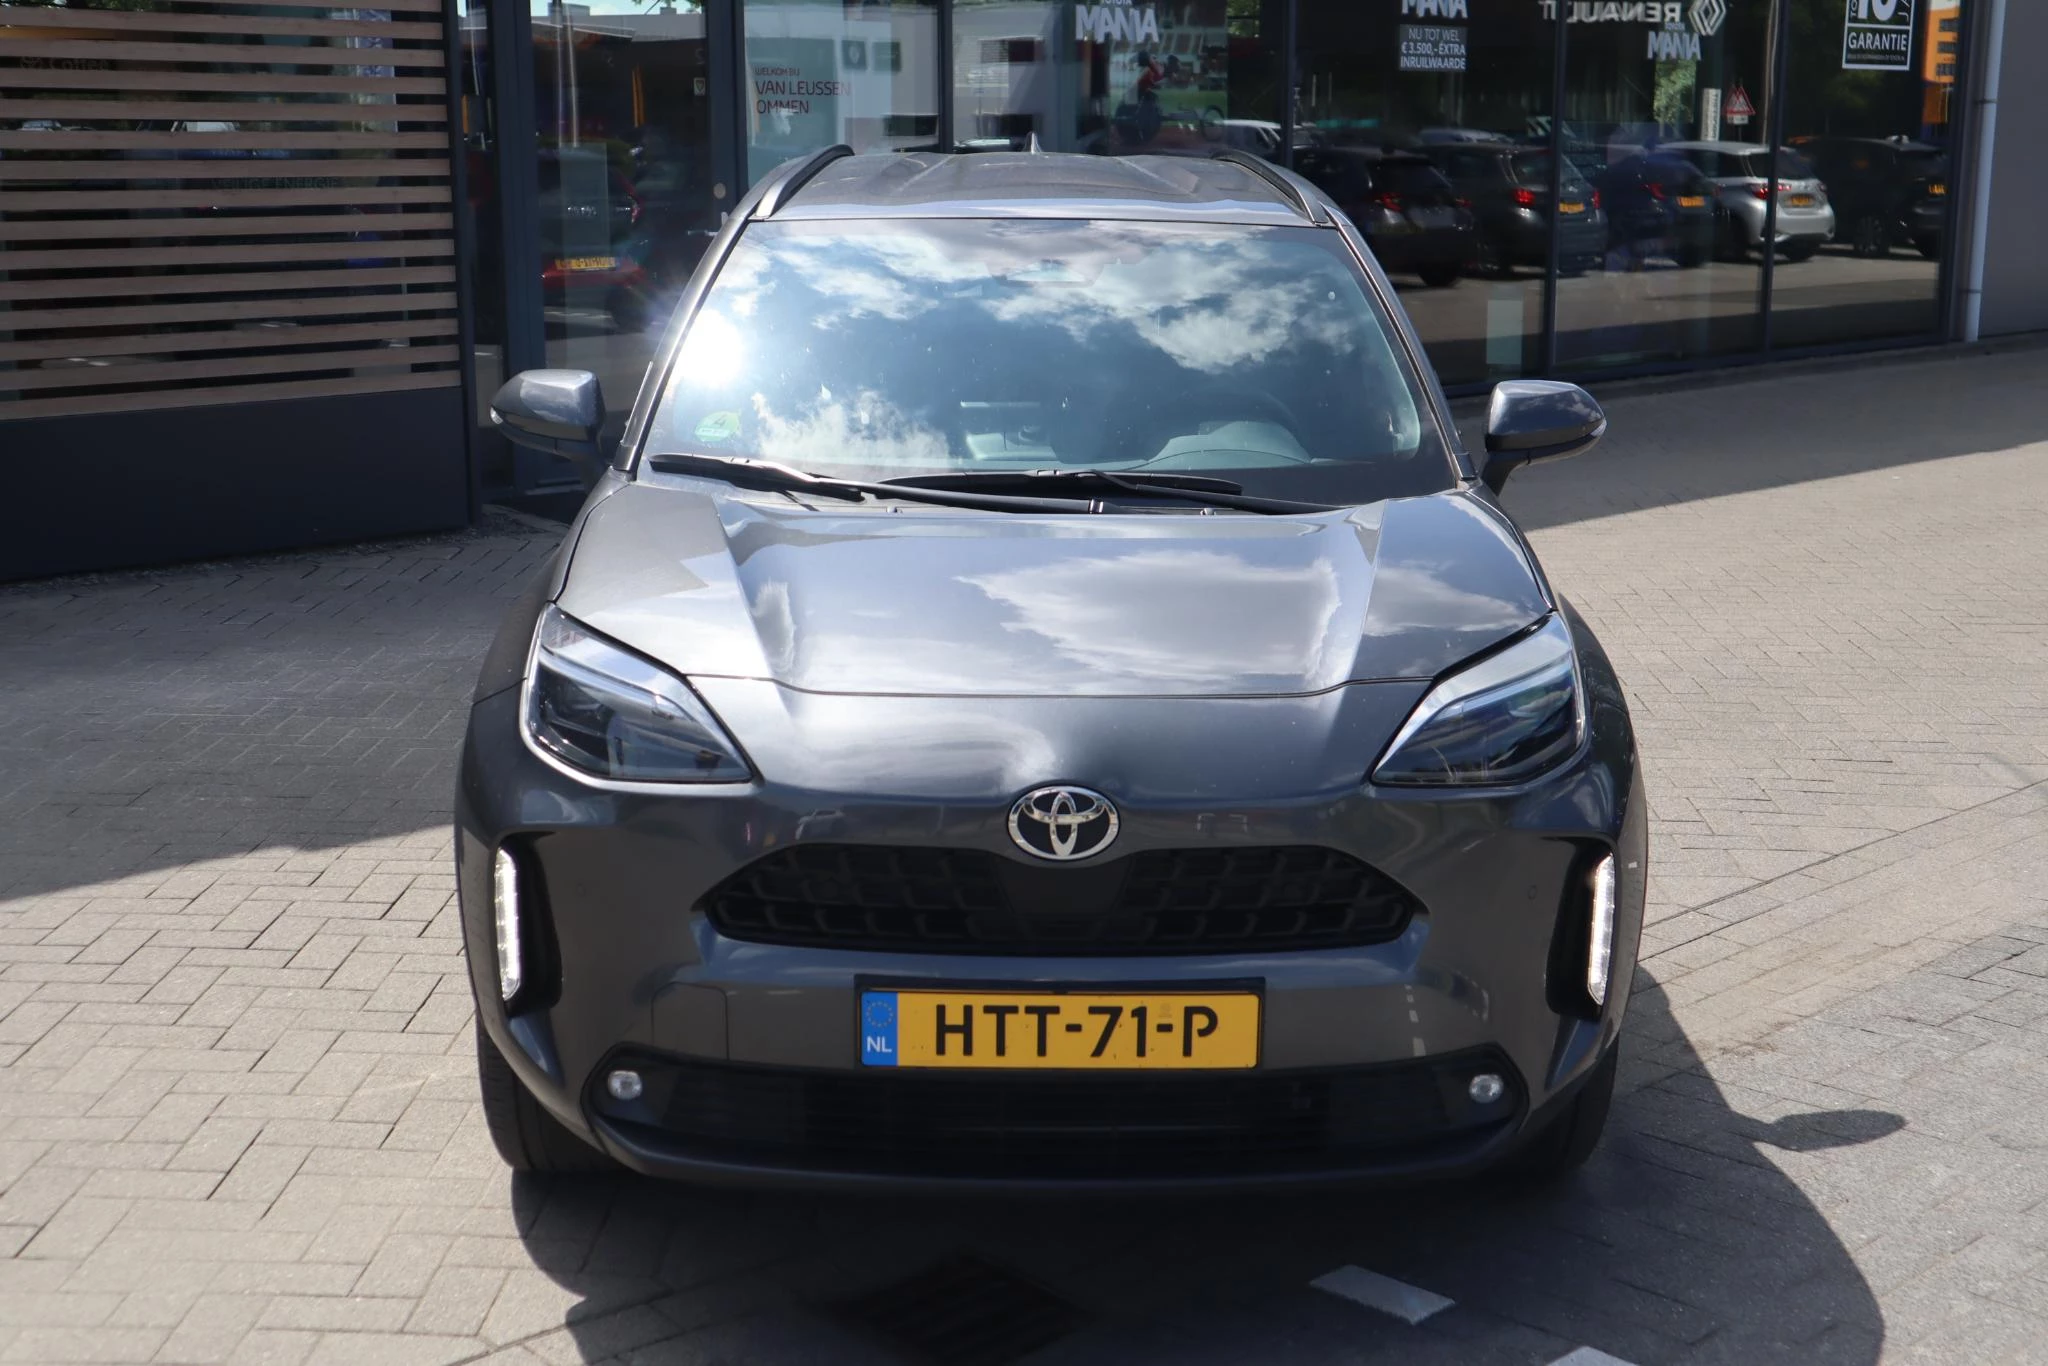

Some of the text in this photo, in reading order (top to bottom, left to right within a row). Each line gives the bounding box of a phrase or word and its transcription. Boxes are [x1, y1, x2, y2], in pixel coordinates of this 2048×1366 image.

[1401, 0, 1468, 19] MANIA
[1075, 4, 1159, 44] MANIA
[1408, 28, 1460, 41] NU TOT WEL
[1848, 31, 1908, 51] GARANTIE
[1647, 30, 1701, 61] MANIA
[754, 67, 787, 76] WELKOM
[1400, 56, 1467, 70] INRUILWAARDE
[755, 80, 851, 97] VAN LEUSSEN
[756, 100, 809, 114] OMMEN
[935, 1003, 1219, 1058] HTT-71-P
[866, 1036, 892, 1053] NL
